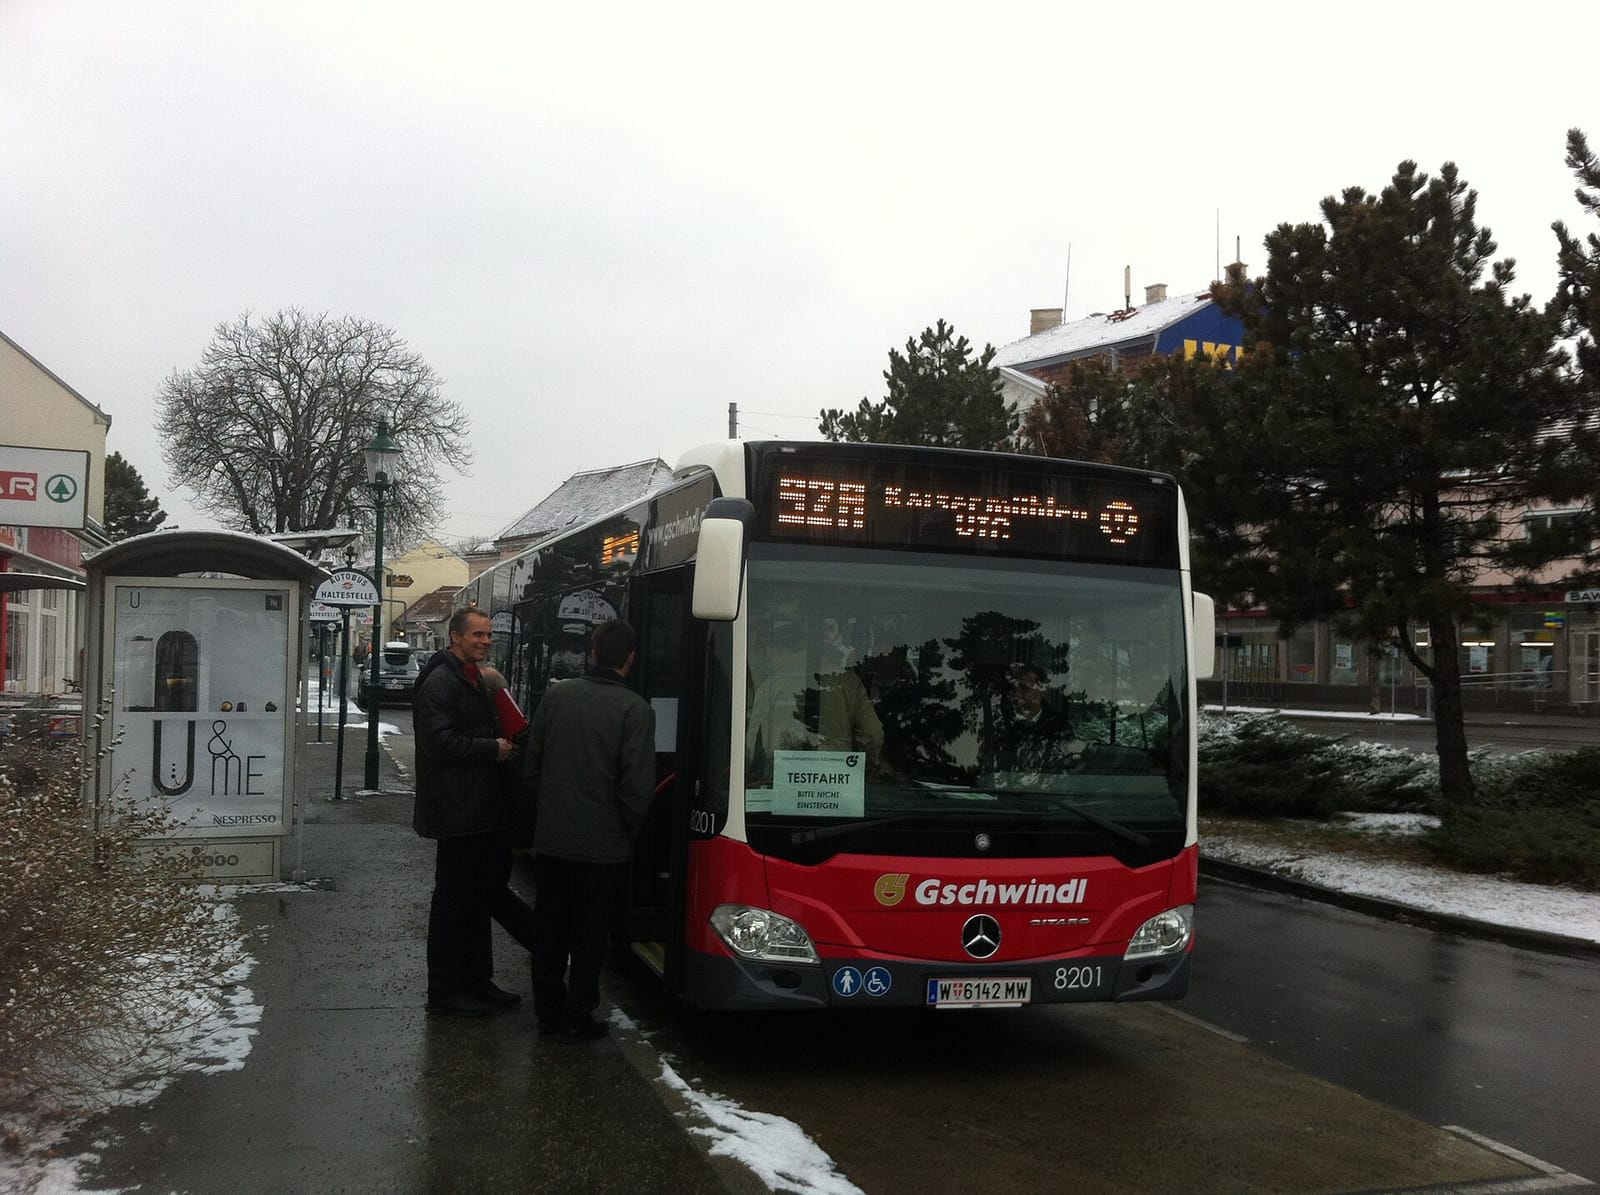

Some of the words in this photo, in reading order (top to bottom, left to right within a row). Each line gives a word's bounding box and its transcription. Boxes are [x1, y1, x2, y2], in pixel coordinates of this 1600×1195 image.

[0, 476, 35, 496] R
[329, 573, 368, 586] AUTOBUS
[321, 591, 374, 600] HALTESTELLE
[152, 719, 196, 796] U
[788, 772, 850, 784] TESTFAHRT
[817, 791, 840, 799] NICHT
[797, 801, 839, 809] EINSTEIGEN
[212, 814, 277, 826] NESPRESSO
[691, 809, 715, 834] 8201
[914, 878, 1088, 906] Gschwindl
[1053, 966, 1102, 990] 8201
